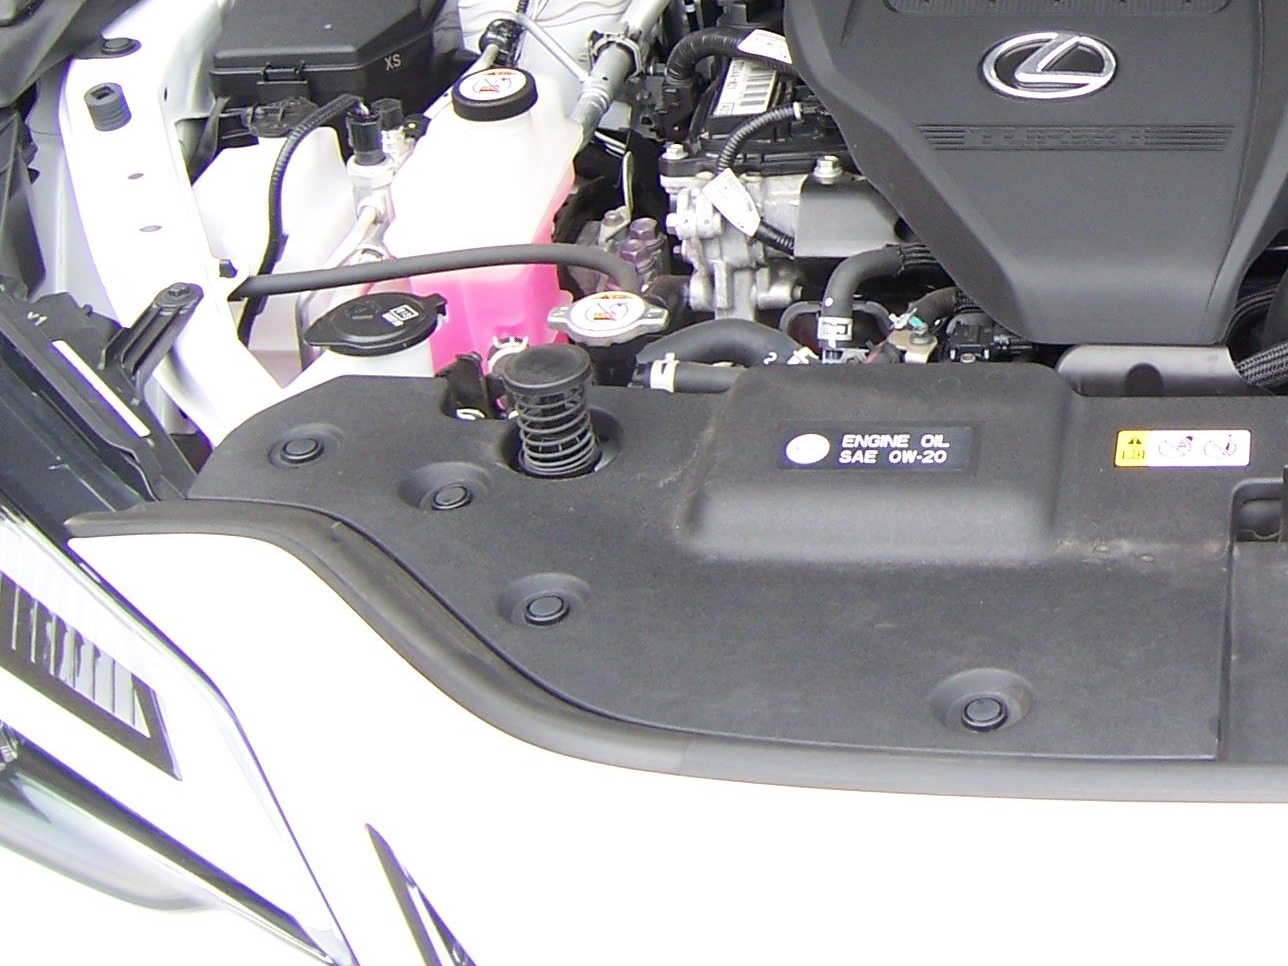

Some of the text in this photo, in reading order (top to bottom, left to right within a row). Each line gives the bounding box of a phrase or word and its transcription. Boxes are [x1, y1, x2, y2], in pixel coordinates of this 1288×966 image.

[383, 54, 402, 71] XS
[841, 434, 950, 447] ENGINE OIL
[839, 450, 948, 463] SAE 0W-20
